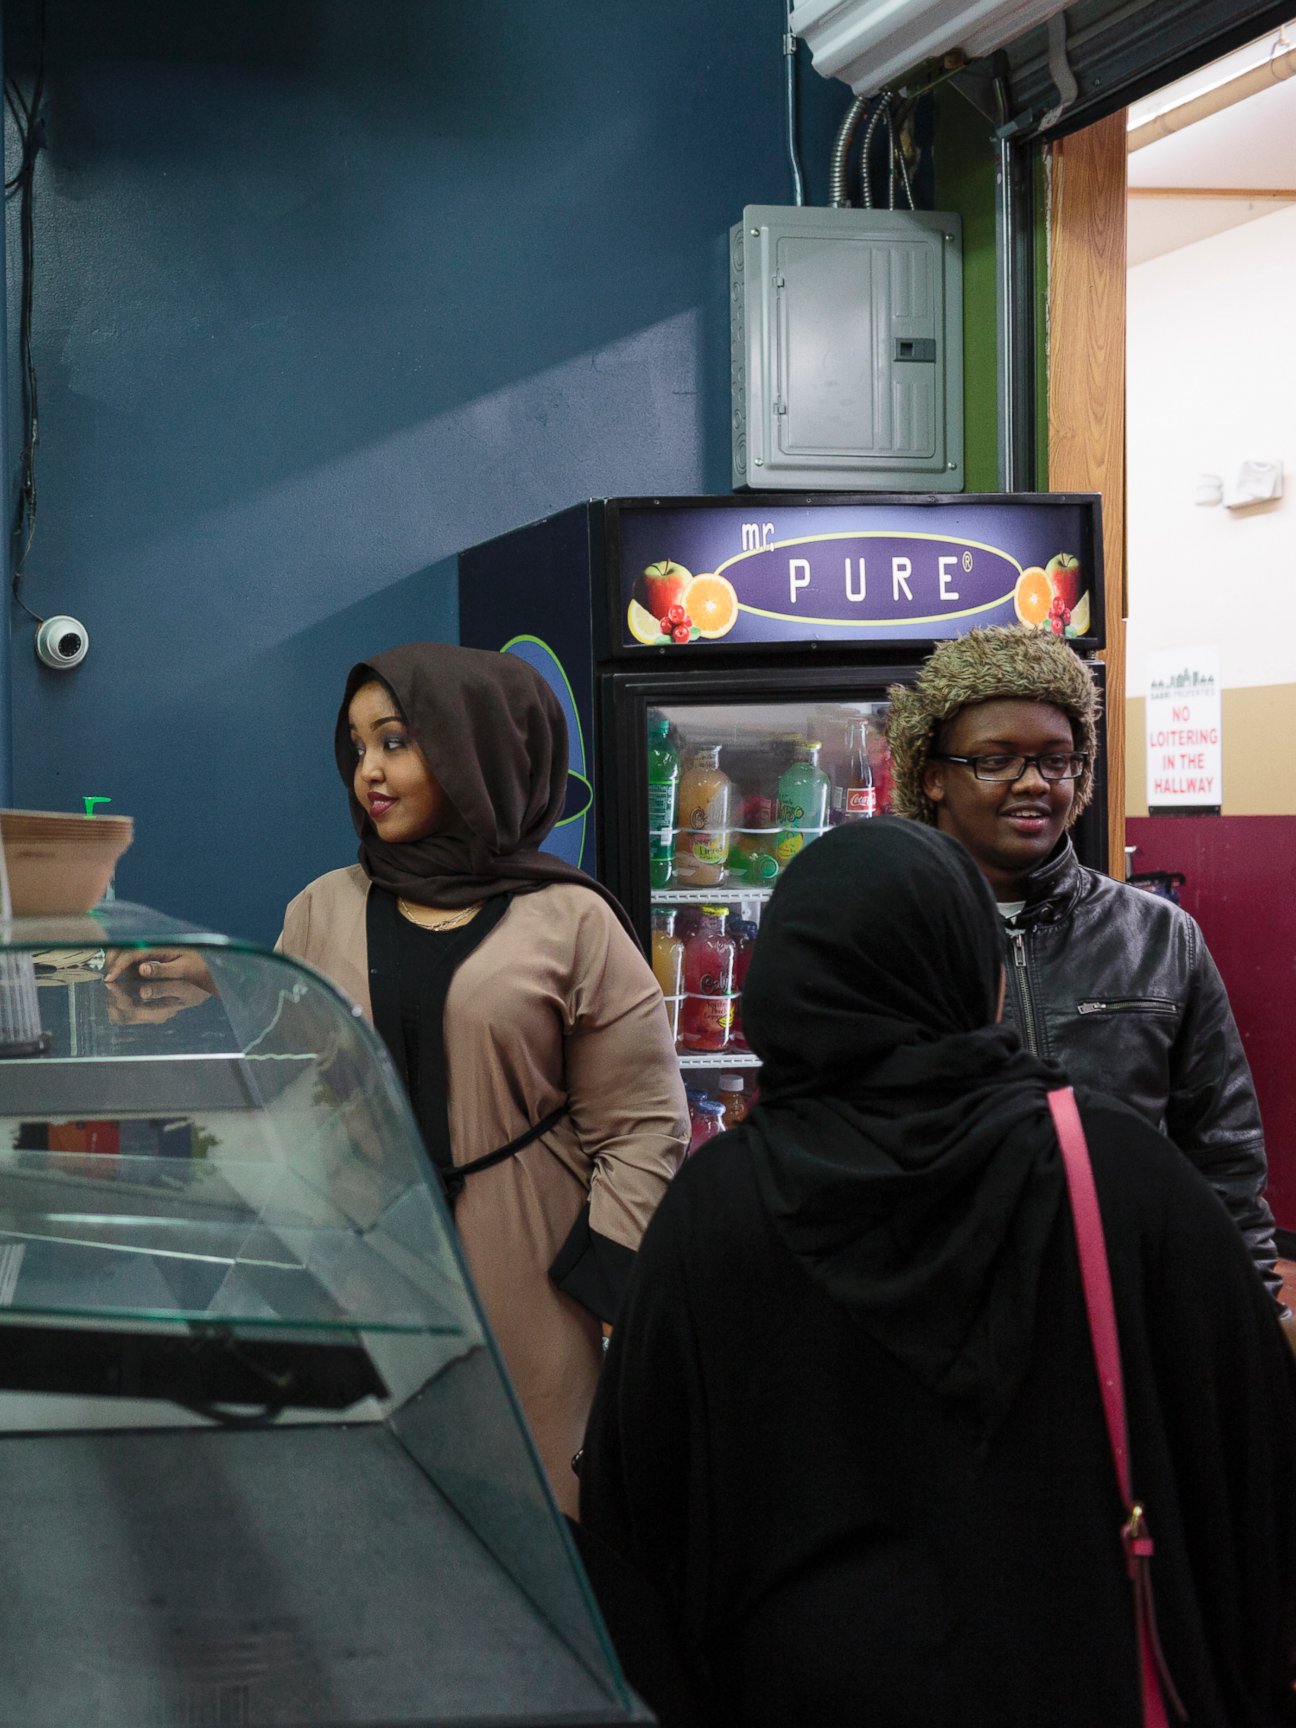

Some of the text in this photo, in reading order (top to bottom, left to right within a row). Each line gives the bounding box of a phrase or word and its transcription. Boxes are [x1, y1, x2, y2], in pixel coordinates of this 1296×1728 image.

[742, 522, 775, 552] mr.
[1172, 706, 1191, 722] NO
[1149, 728, 1219, 748] LOITERING
[1162, 753, 1205, 770] IN THE
[1154, 776, 1214, 794] HALLWAY
